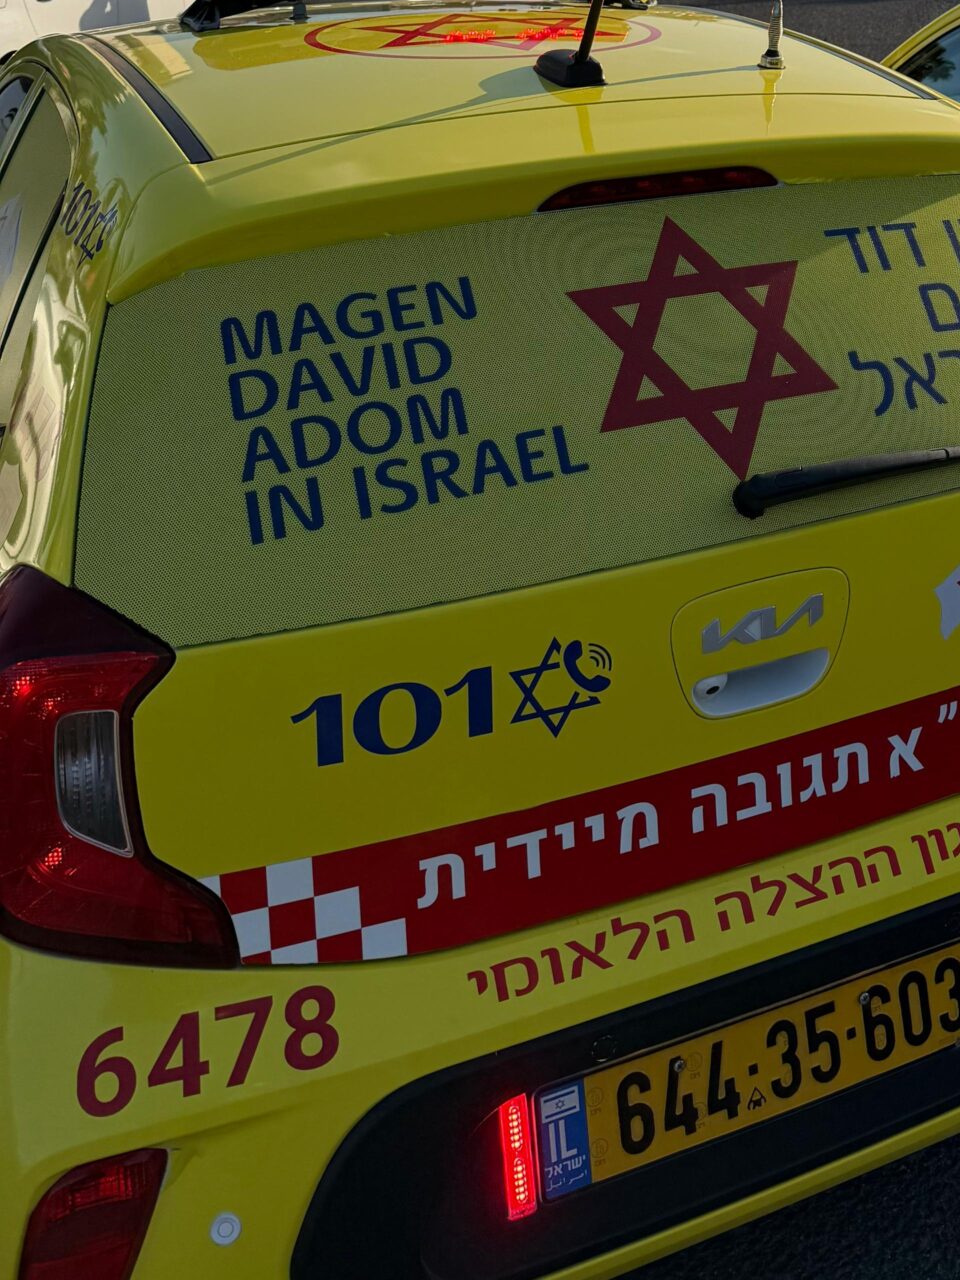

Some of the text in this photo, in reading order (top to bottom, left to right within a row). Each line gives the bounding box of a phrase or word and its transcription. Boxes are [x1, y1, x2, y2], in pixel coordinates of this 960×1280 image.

[60, 181, 102, 246] 101
[824, 222, 926, 273] דוד
[220, 276, 478, 365] MAGEN
[228, 336, 452, 421] DAVID
[242, 387, 469, 482] ADOM
[245, 425, 590, 545] IN ISRAEL
[290, 666, 494, 767] 101
[691, 741, 870, 833] תגובה
[416, 802, 660, 910] מיידית
[714, 844, 902, 933] ההצלה
[466, 907, 696, 1003] הלאומי
[76, 985, 340, 1118] 6478
[545, 1154, 587, 1178] ישראל
[548, 1119, 578, 1163] IL
